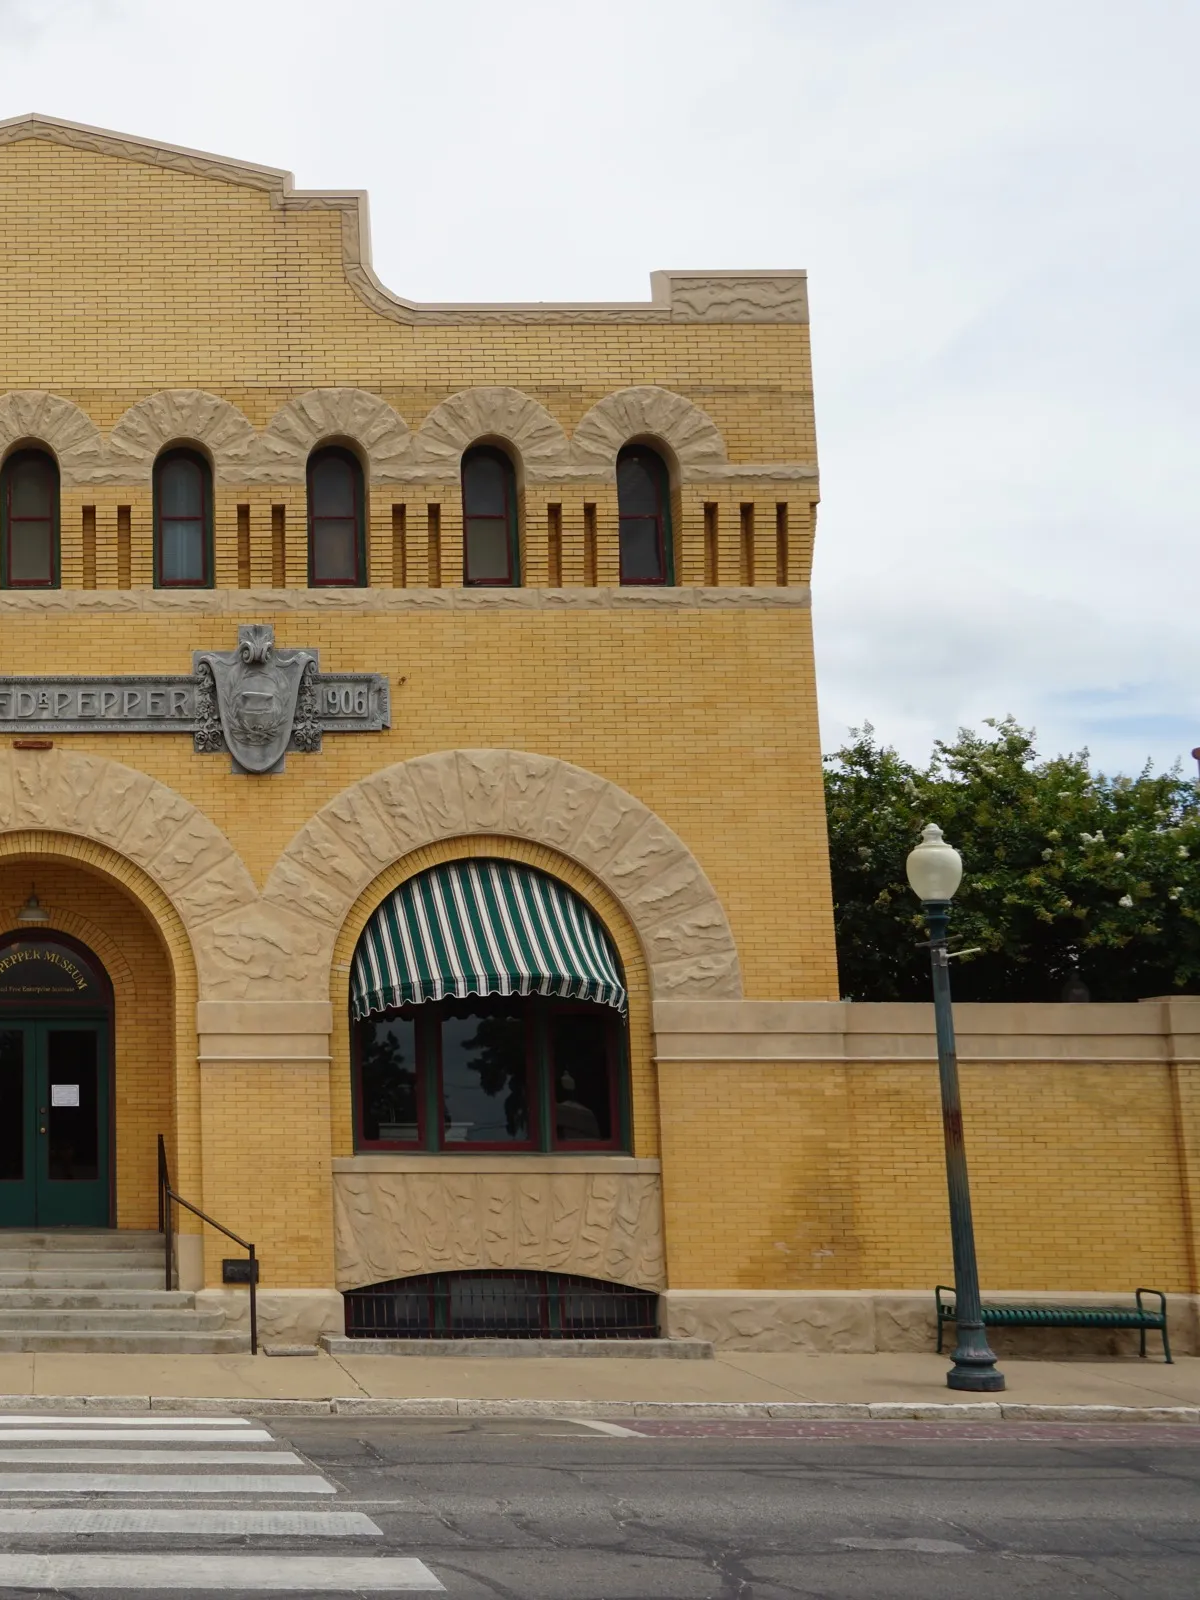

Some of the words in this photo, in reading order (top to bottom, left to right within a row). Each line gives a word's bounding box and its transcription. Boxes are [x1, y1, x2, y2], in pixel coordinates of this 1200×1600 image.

[54, 690, 190, 717] PEPPER
[323, 687, 368, 716] 1906
[43, 951, 88, 990] MUSEUM
